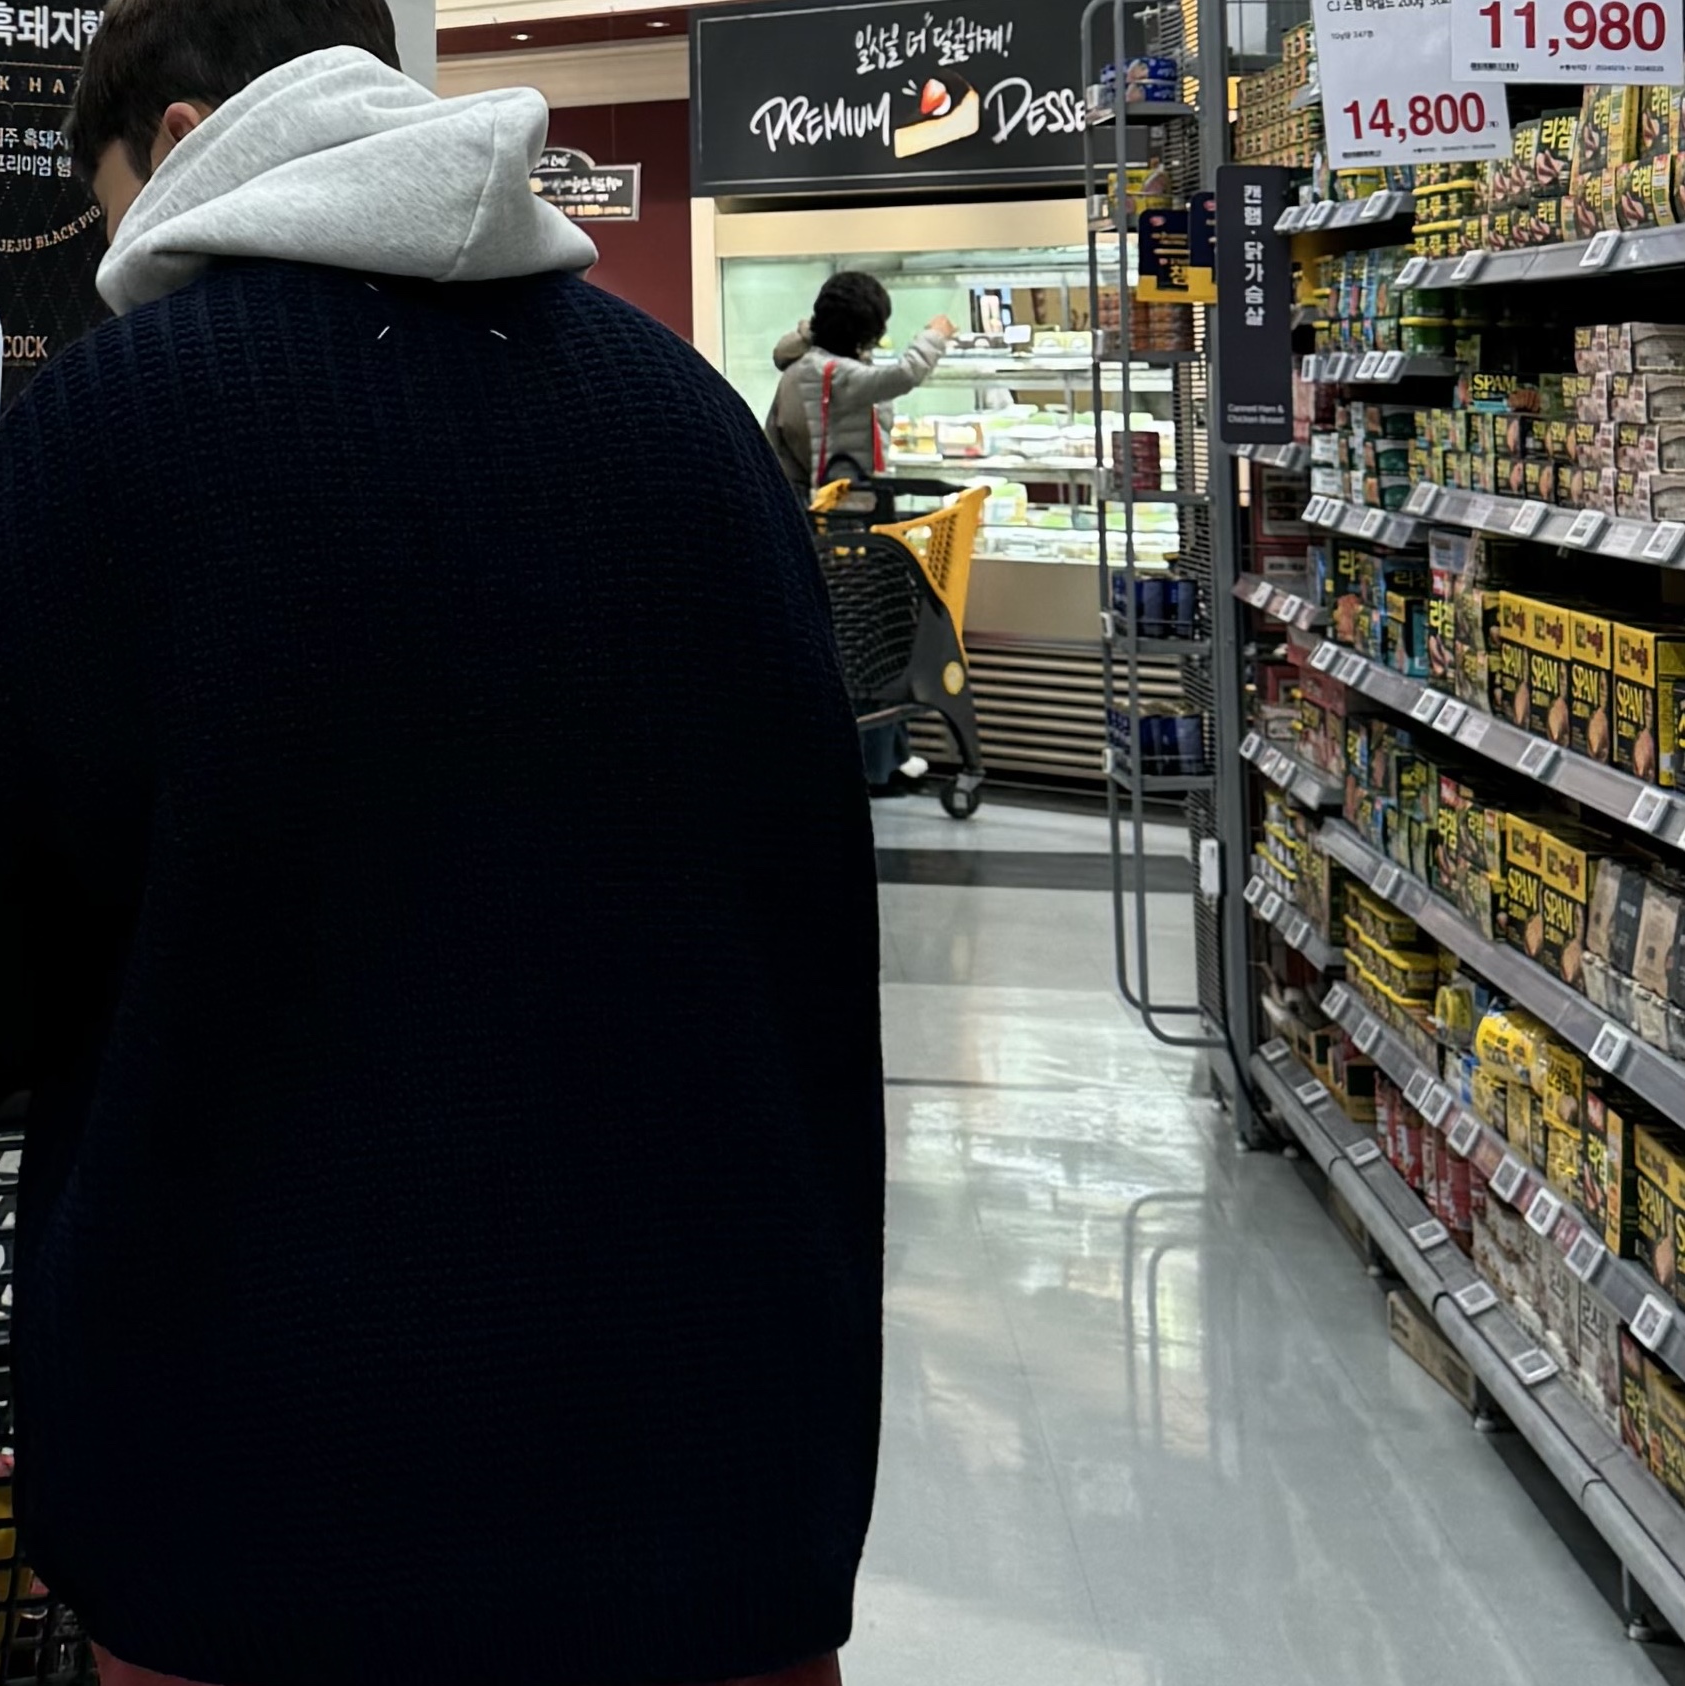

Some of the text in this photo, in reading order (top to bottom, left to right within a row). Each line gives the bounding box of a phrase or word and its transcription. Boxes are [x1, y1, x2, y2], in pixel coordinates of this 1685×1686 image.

[855, 16, 1014, 75] 일상을 더 달콤하게!
[1479, 1, 1666, 58] 11,980
[28, 78, 80, 95] HA
[749, 92, 892, 153] PREMIUM
[1343, 91, 1486, 144] 14,800
[1541, 116, 1577, 150] 리챔
[1631, 163, 1652, 199] 리챔
[35, 223, 80, 251] BLACK
[79, 204, 102, 230] PIG
[1473, 373, 1516, 393] SPAM
[1531, 654, 1559, 694] SPAM
[1571, 663, 1599, 705] SPAM
[1616, 681, 1644, 726] SPAM
[1507, 867, 1538, 914] SPAM
[1543, 888, 1574, 938] SPAM
